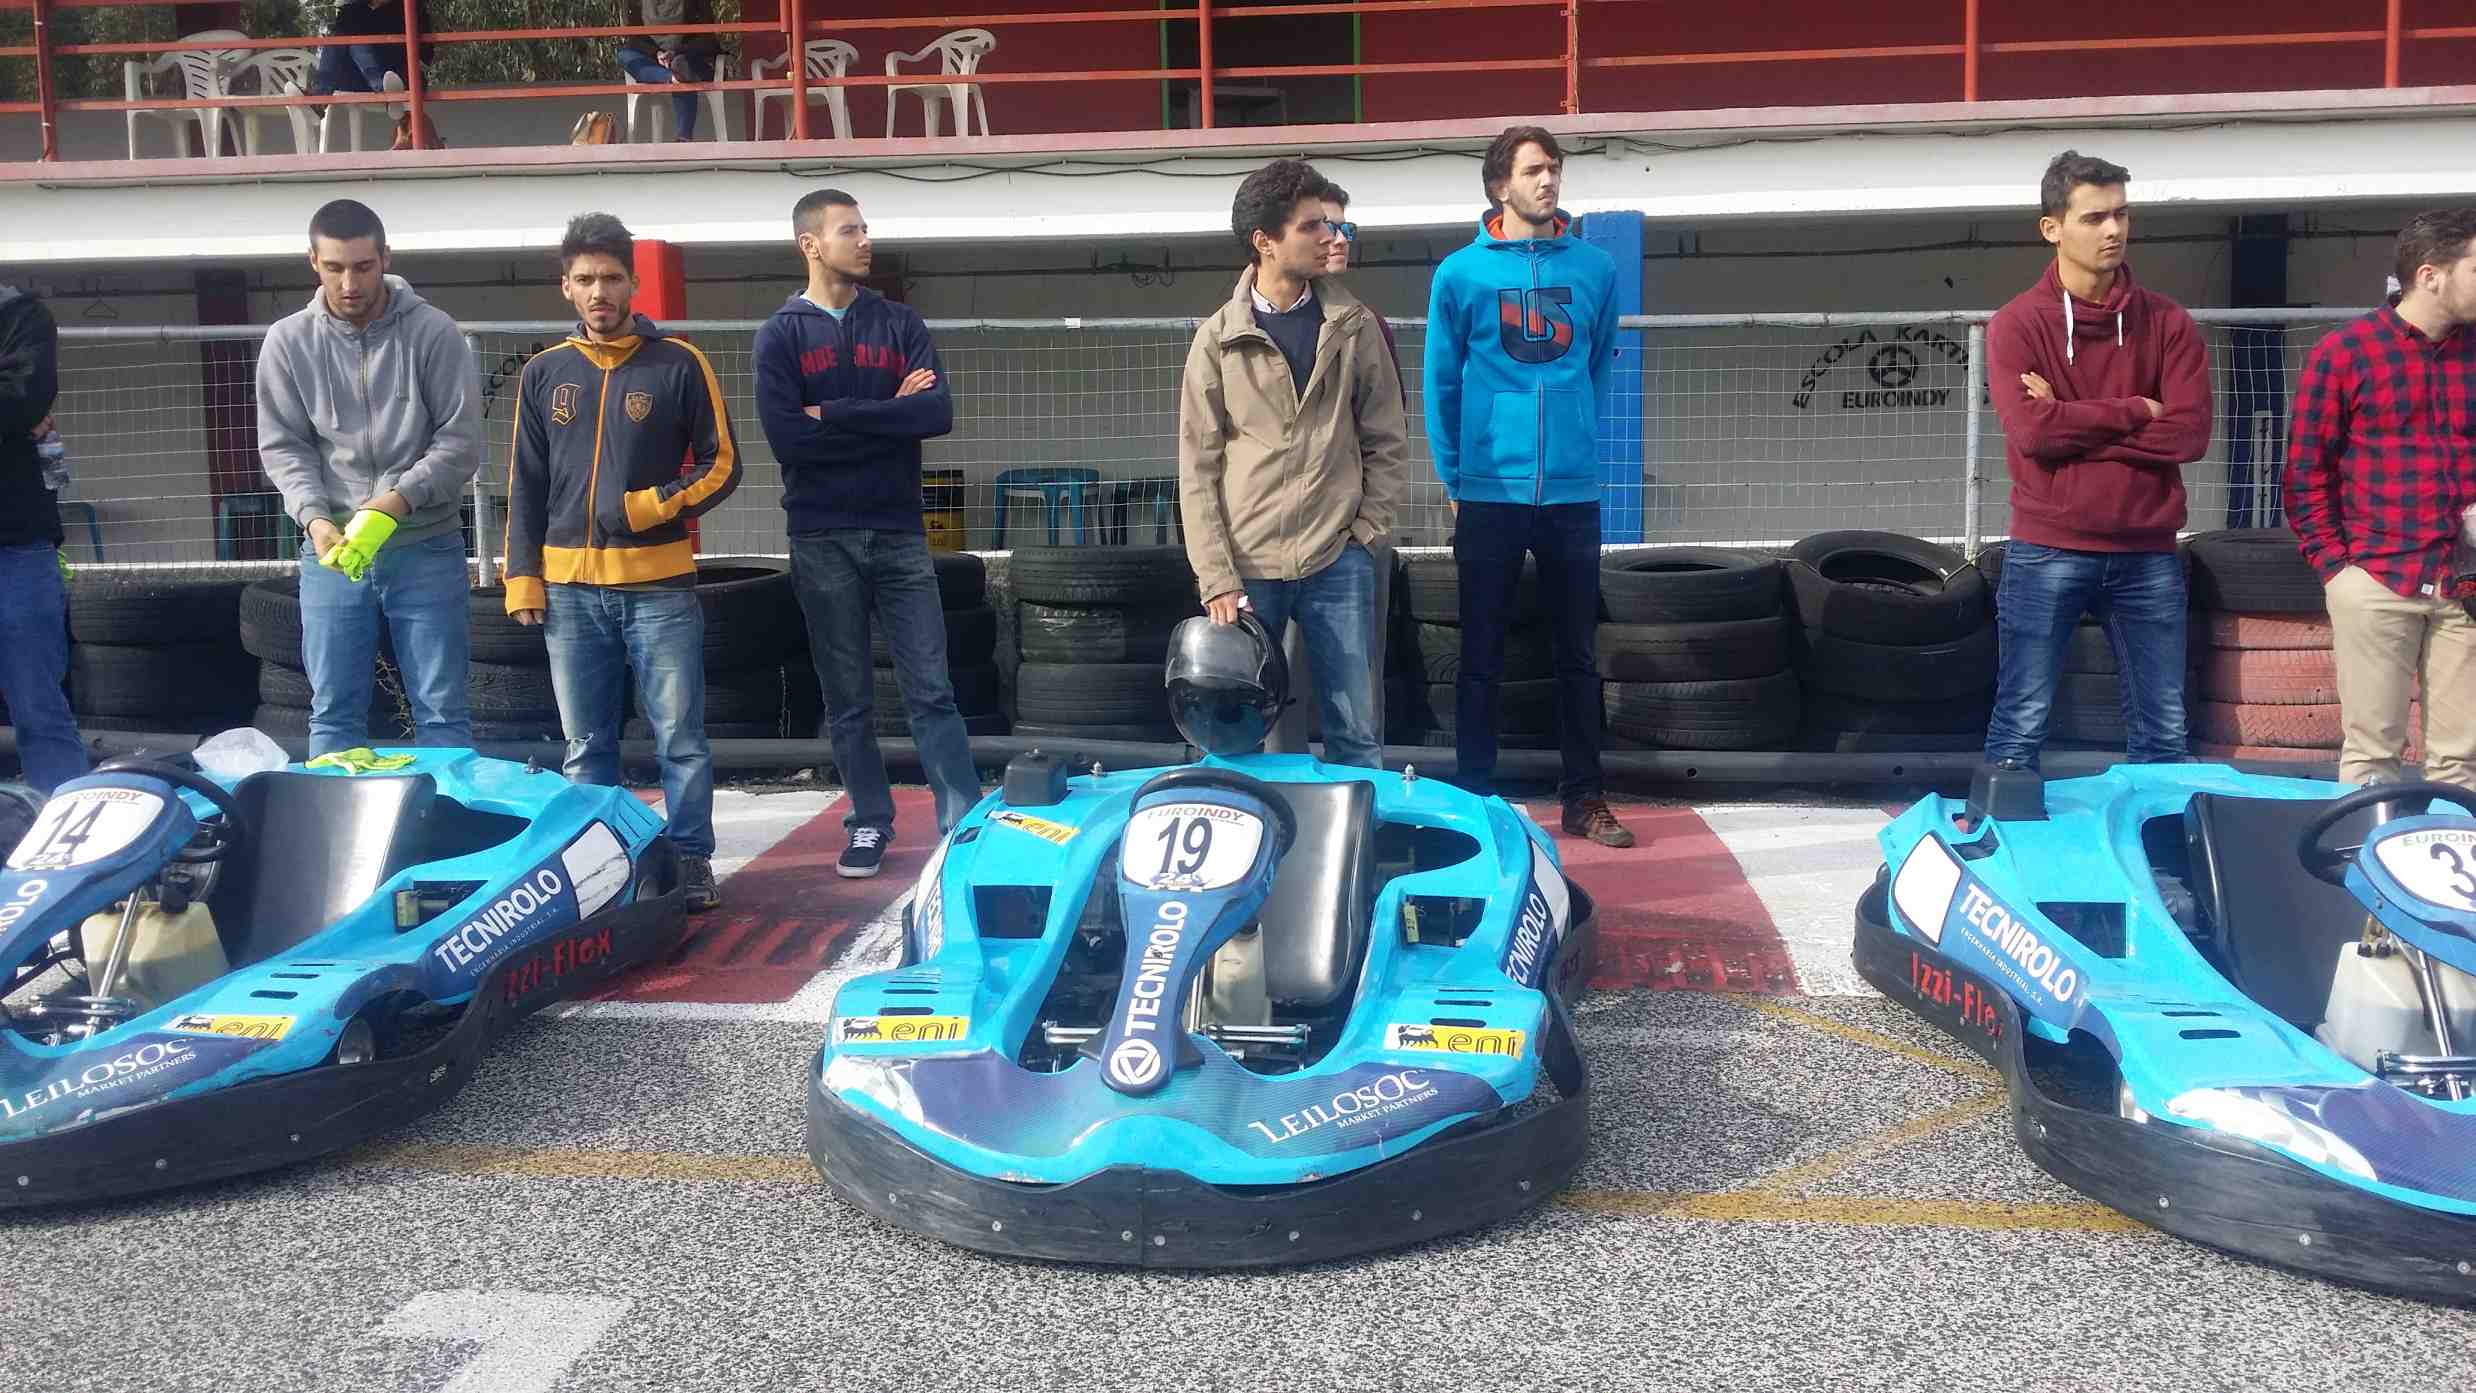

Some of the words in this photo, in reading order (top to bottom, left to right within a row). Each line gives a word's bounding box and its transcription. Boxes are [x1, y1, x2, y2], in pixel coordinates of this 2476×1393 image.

[1792, 328, 1878, 408] ESCOLA
[1842, 390, 1950, 409] EUROINDY
[36, 801, 108, 857] 14
[1157, 816, 1213, 876] 19
[2430, 842, 2476, 900] 3
[434, 868, 562, 973] TECNIROLO
[1506, 893, 1546, 985] ECNIROLO
[1960, 882, 2077, 1002] TECNIROLO
[1125, 900, 1188, 1038] TECNIROLO
[891, 1016, 960, 1041] eni
[1447, 1029, 1518, 1057] eni
[0, 1037, 192, 1119] LEILOSOC
[77, 1076, 137, 1099] MARKET
[136, 1051, 197, 1082] PARTNERS
[1248, 1069, 1431, 1143] LEILOSOC
[1336, 1108, 1381, 1130] MARKET
[1381, 1087, 1439, 1115] PARTNERS
